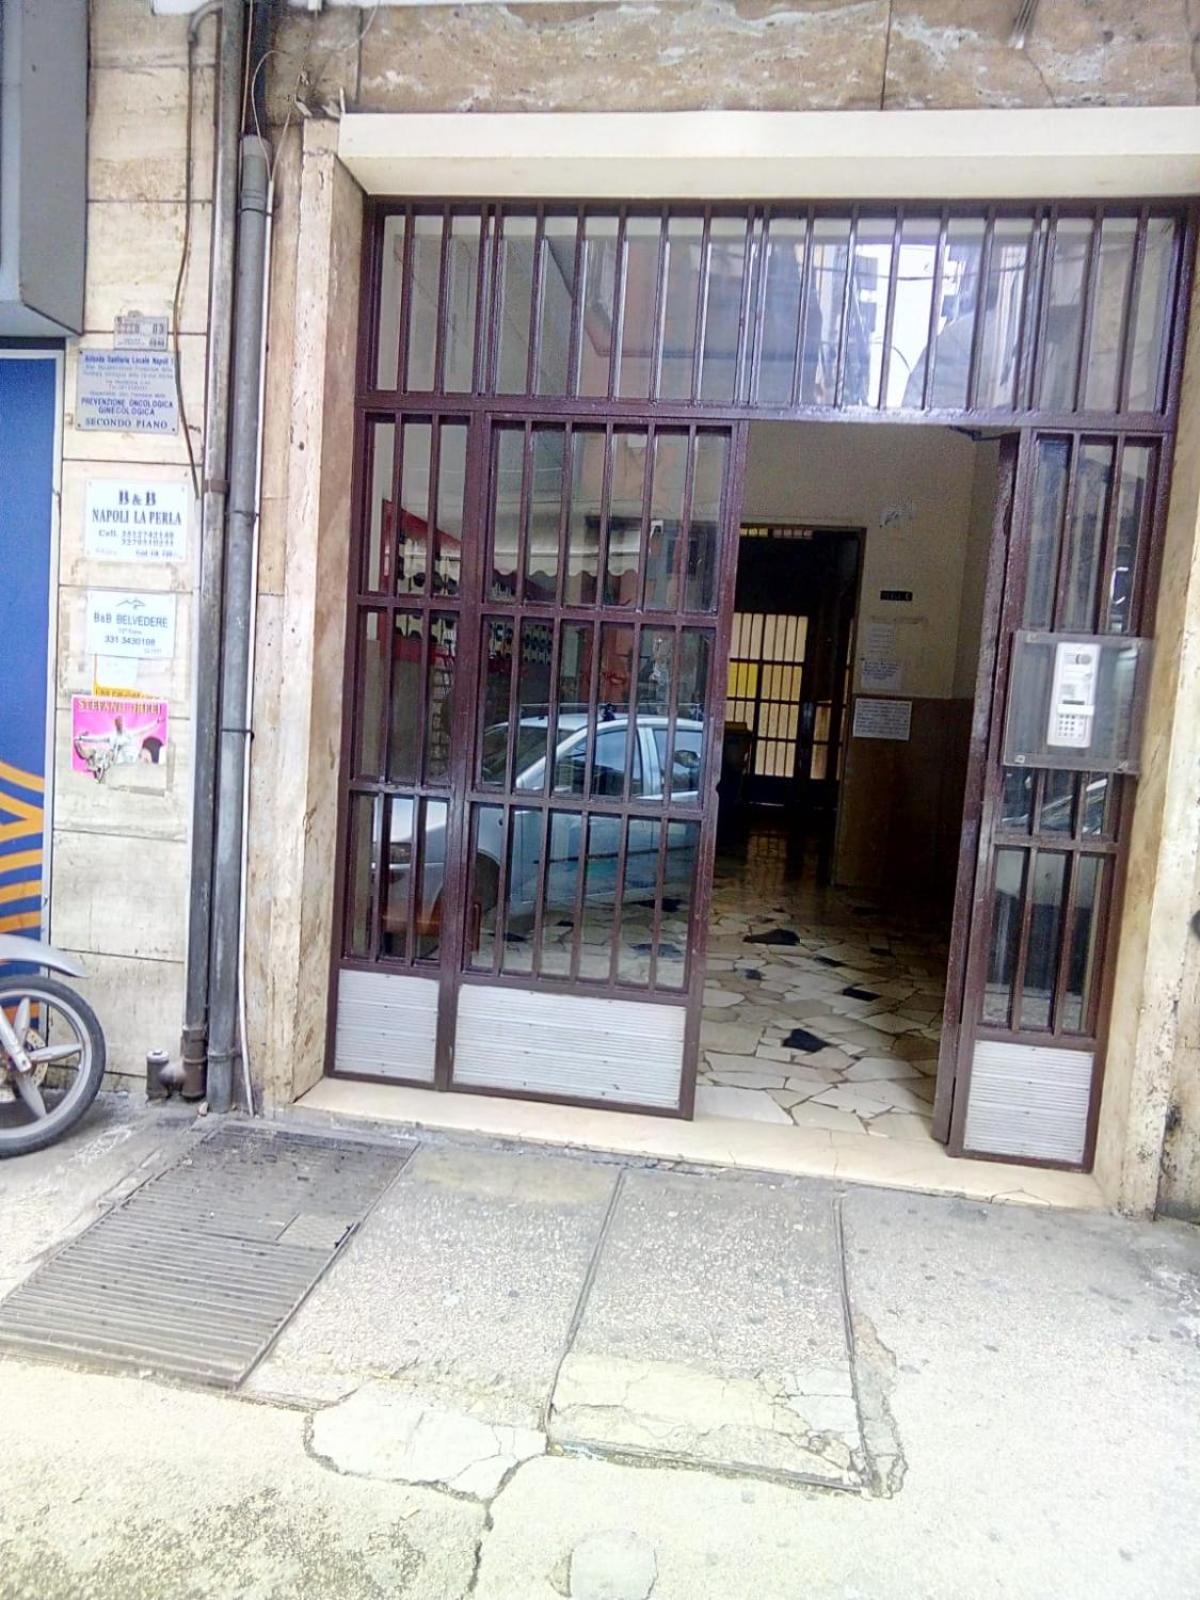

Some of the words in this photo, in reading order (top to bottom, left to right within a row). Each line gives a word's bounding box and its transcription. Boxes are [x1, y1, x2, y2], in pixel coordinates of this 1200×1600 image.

[81, 397, 126, 407] PREVENZIONE
[129, 398, 173, 408] ONCOLOGICA
[98, 406, 155, 416] GINECOLOGICA
[85, 417, 131, 428] SECONDO
[136, 417, 168, 429] PIANO
[92, 509, 129, 523] NAPOLI
[134, 511, 146, 525] LA
[149, 511, 182, 526] PERLA
[93, 611, 112, 624] B&B
[116, 613, 168, 629] BELVEDERE
